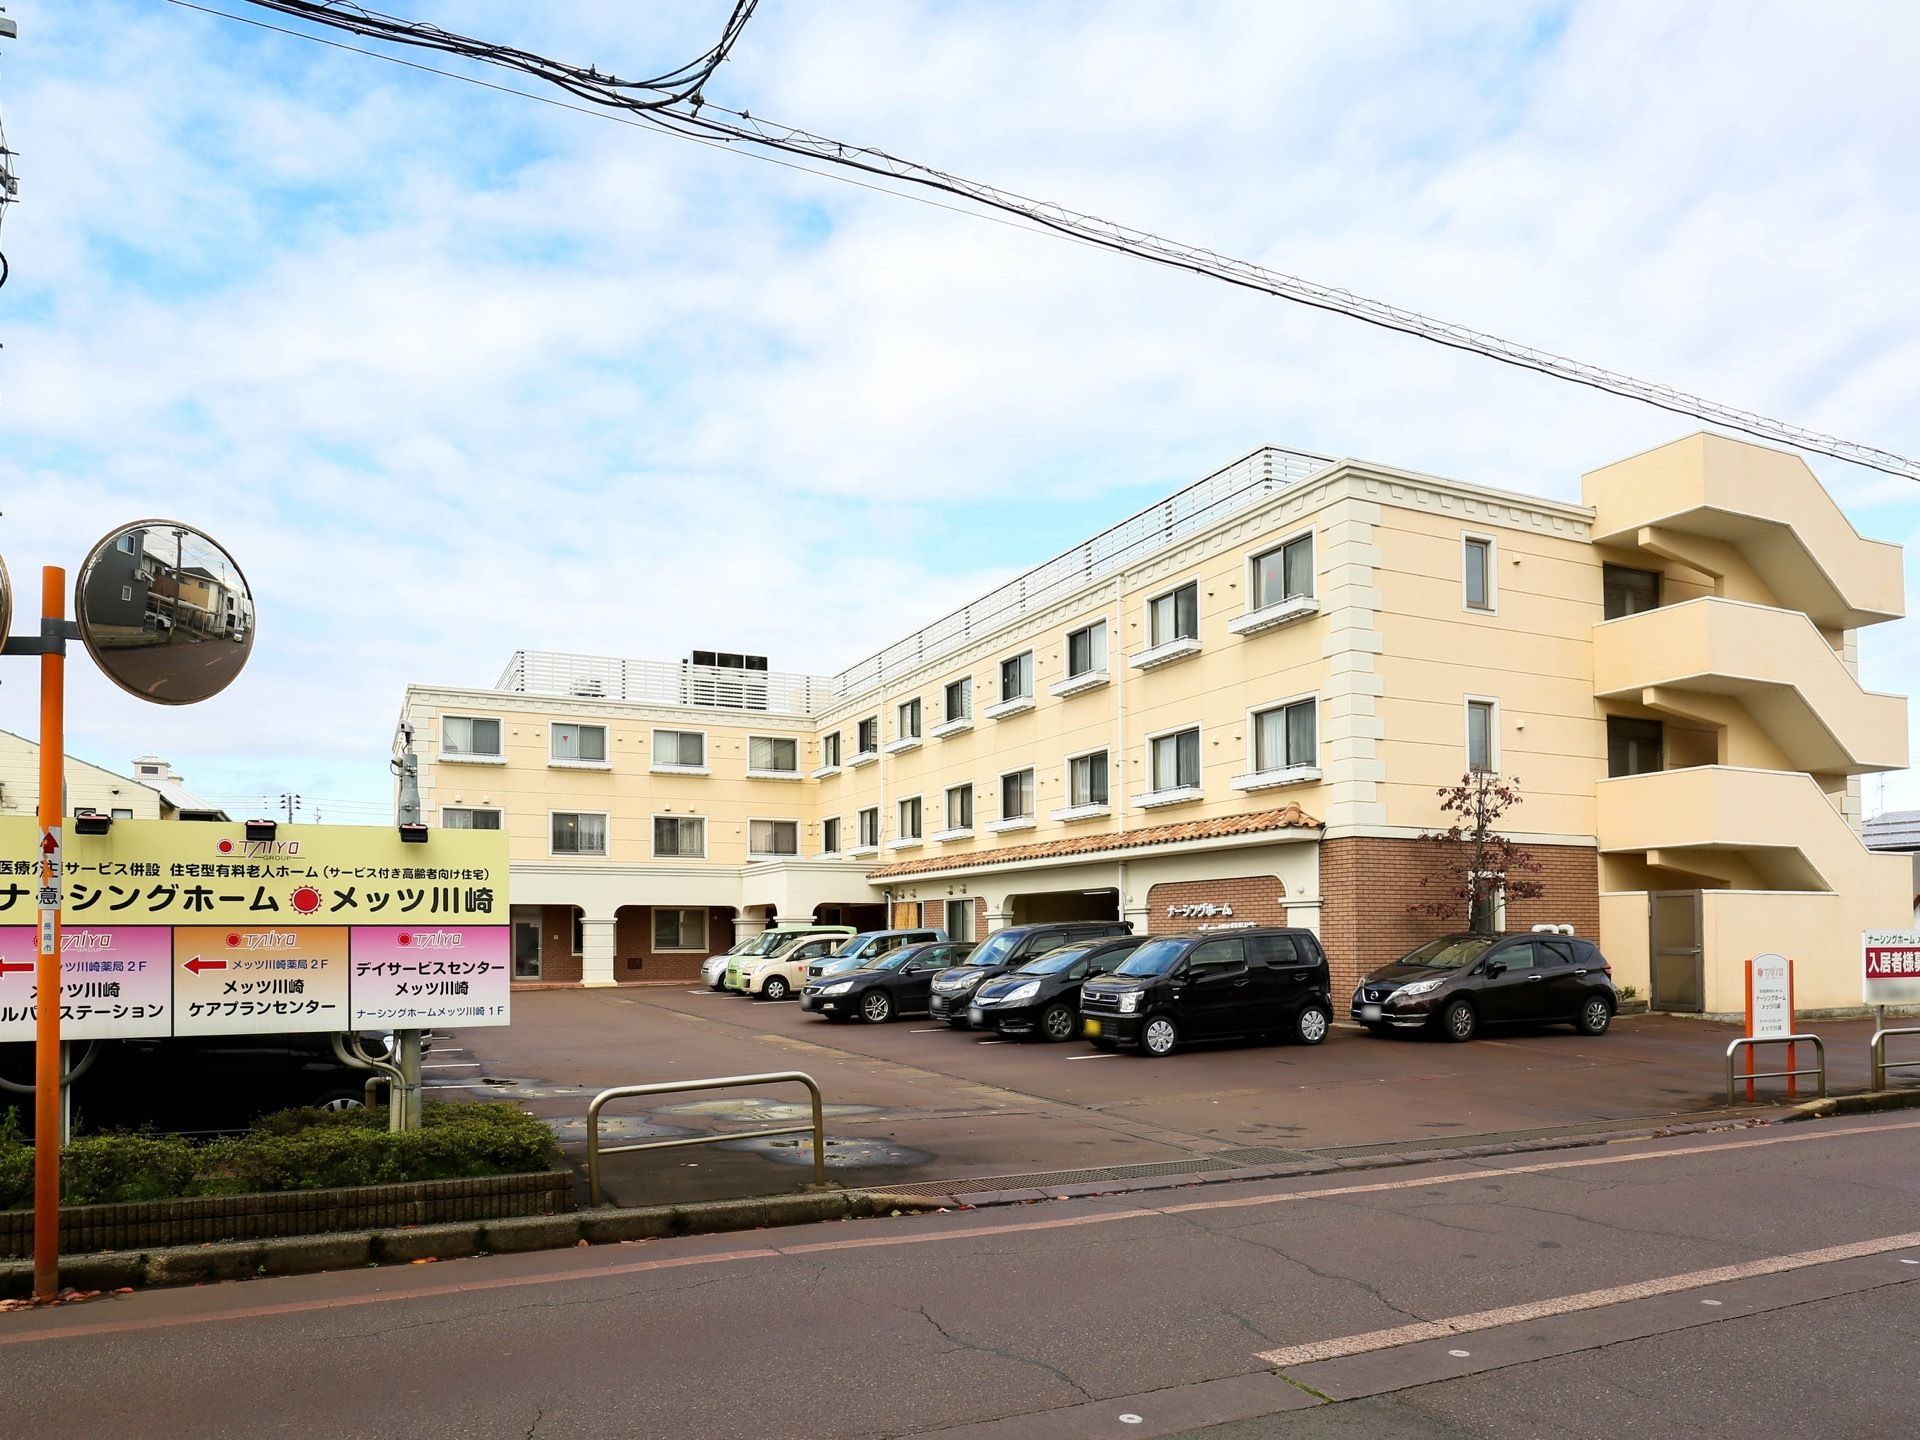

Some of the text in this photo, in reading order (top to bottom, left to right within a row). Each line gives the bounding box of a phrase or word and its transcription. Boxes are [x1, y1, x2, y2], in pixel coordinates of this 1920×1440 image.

[0, 860, 160, 877] 医療サービス併設
[0, 883, 494, 914] ナシングホーム メッツ川崎
[1167, 903, 1233, 918] ナーシングホーム
[1868, 934, 1915, 944] ナーシングホーム
[356, 961, 505, 977] デイサービスセンター
[223, 979, 304, 995] メッツ川崎
[395, 981, 469, 996] メッツ川崎
[189, 1000, 336, 1017] ケアプランセンター
